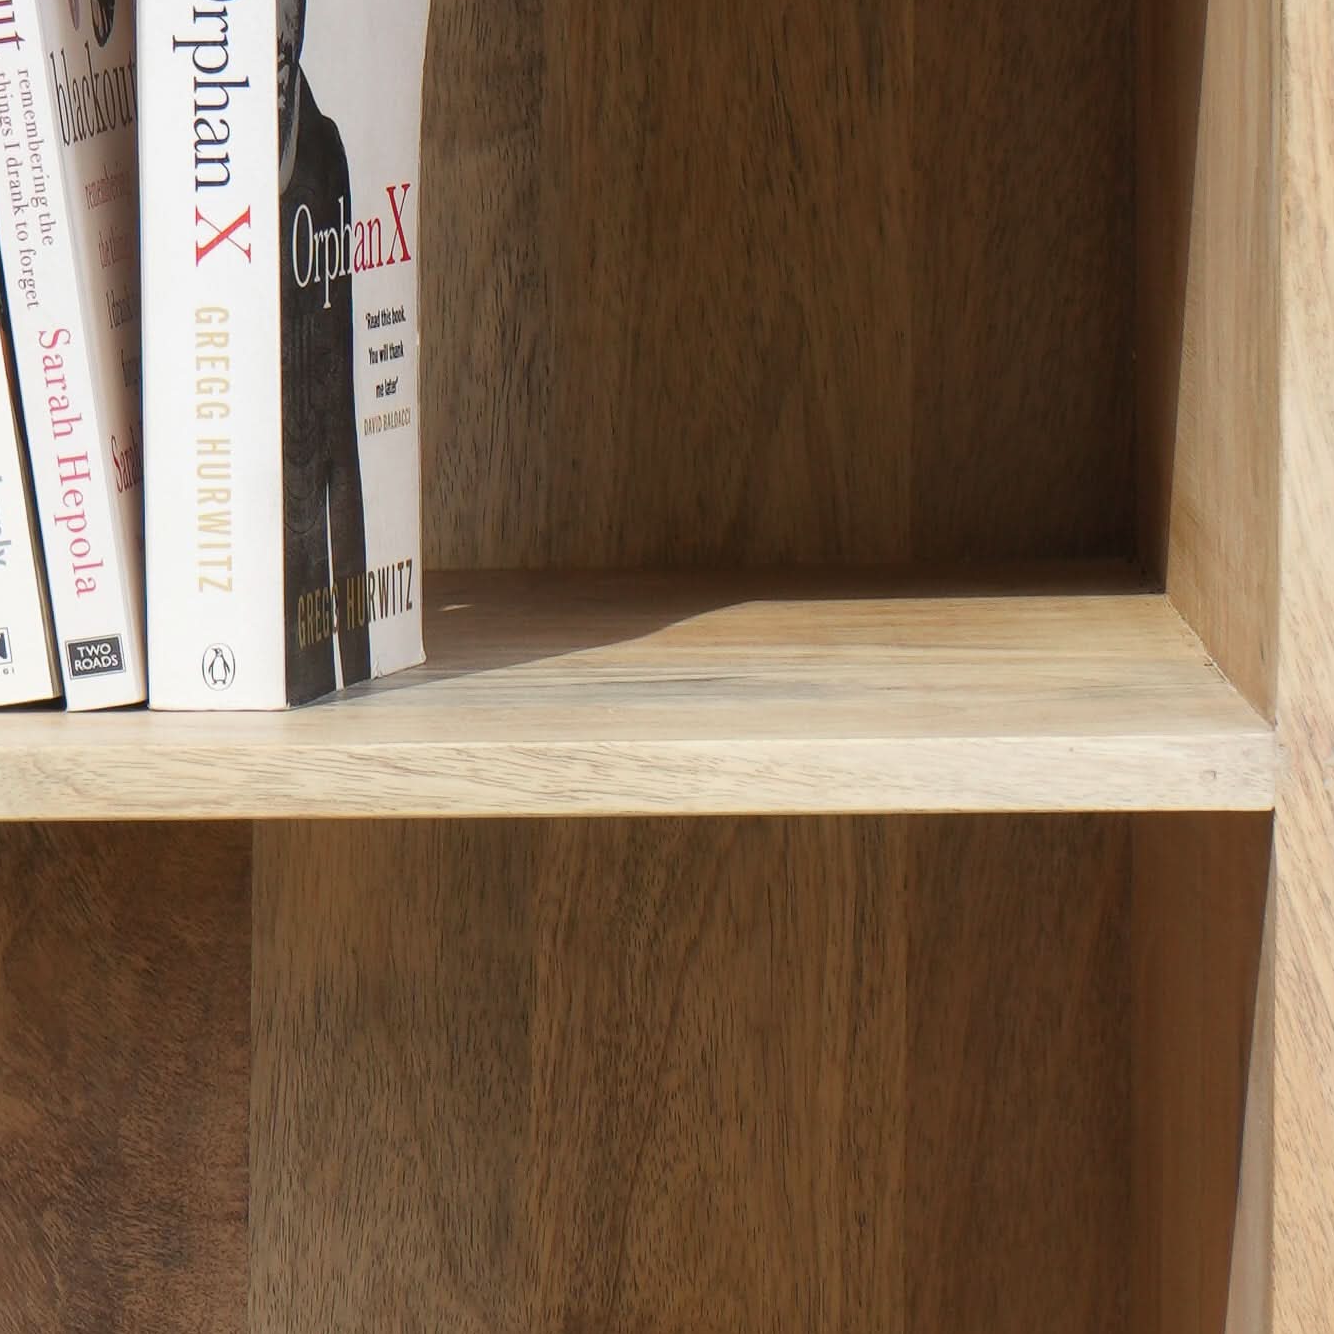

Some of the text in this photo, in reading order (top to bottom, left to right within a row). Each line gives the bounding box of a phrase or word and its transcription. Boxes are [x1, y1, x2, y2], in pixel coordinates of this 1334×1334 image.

[4, 142, 20, 151] I
[17, 69, 57, 246] remembering the
[5, 156, 29, 217] drank
[15, 221, 29, 242] to
[195, 203, 252, 268] X
[292, 183, 412, 309] Orphan X
[18, 248, 40, 311] forget
[381, 307, 392, 327] this
[368, 340, 404, 365] You will thank
[195, 306, 234, 594] GREGG HURWITZ
[364, 408, 411, 436] DAVID BALDACCI
[38, 328, 105, 598] Sarah Hepola
[297, 558, 413, 650] GREGG HURWITZ
[74, 654, 119, 672] ROADS
[76, 642, 112, 658] TWO
